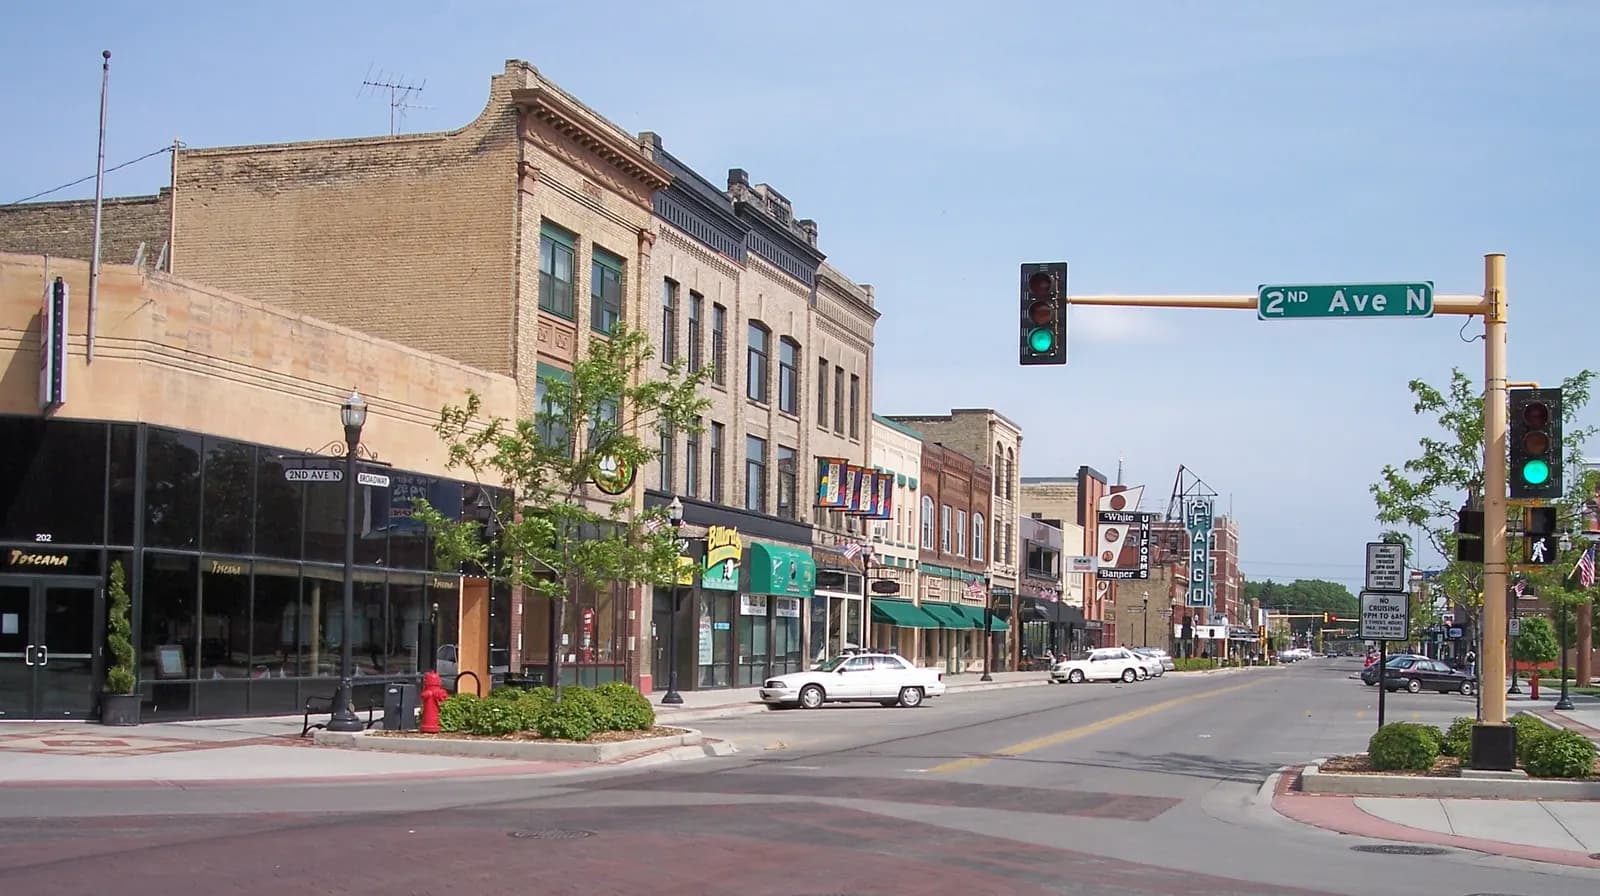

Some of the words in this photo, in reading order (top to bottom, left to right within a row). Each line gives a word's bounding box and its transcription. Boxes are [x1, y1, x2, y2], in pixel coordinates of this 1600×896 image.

[1266, 291, 1308, 313] 2ND
[1328, 290, 1387, 312] Ave
[1406, 289, 1425, 311] N
[289, 471, 308, 480] 2ND
[311, 471, 329, 480] AVE
[333, 472, 340, 480] N
[1104, 512, 1134, 522] White
[35, 534, 52, 542] 202
[1140, 515, 1149, 578] UNIFORMS
[10, 550, 69, 567] Toscana
[1193, 513, 1205, 602] FARGO
[1100, 569, 1134, 579] Banner
